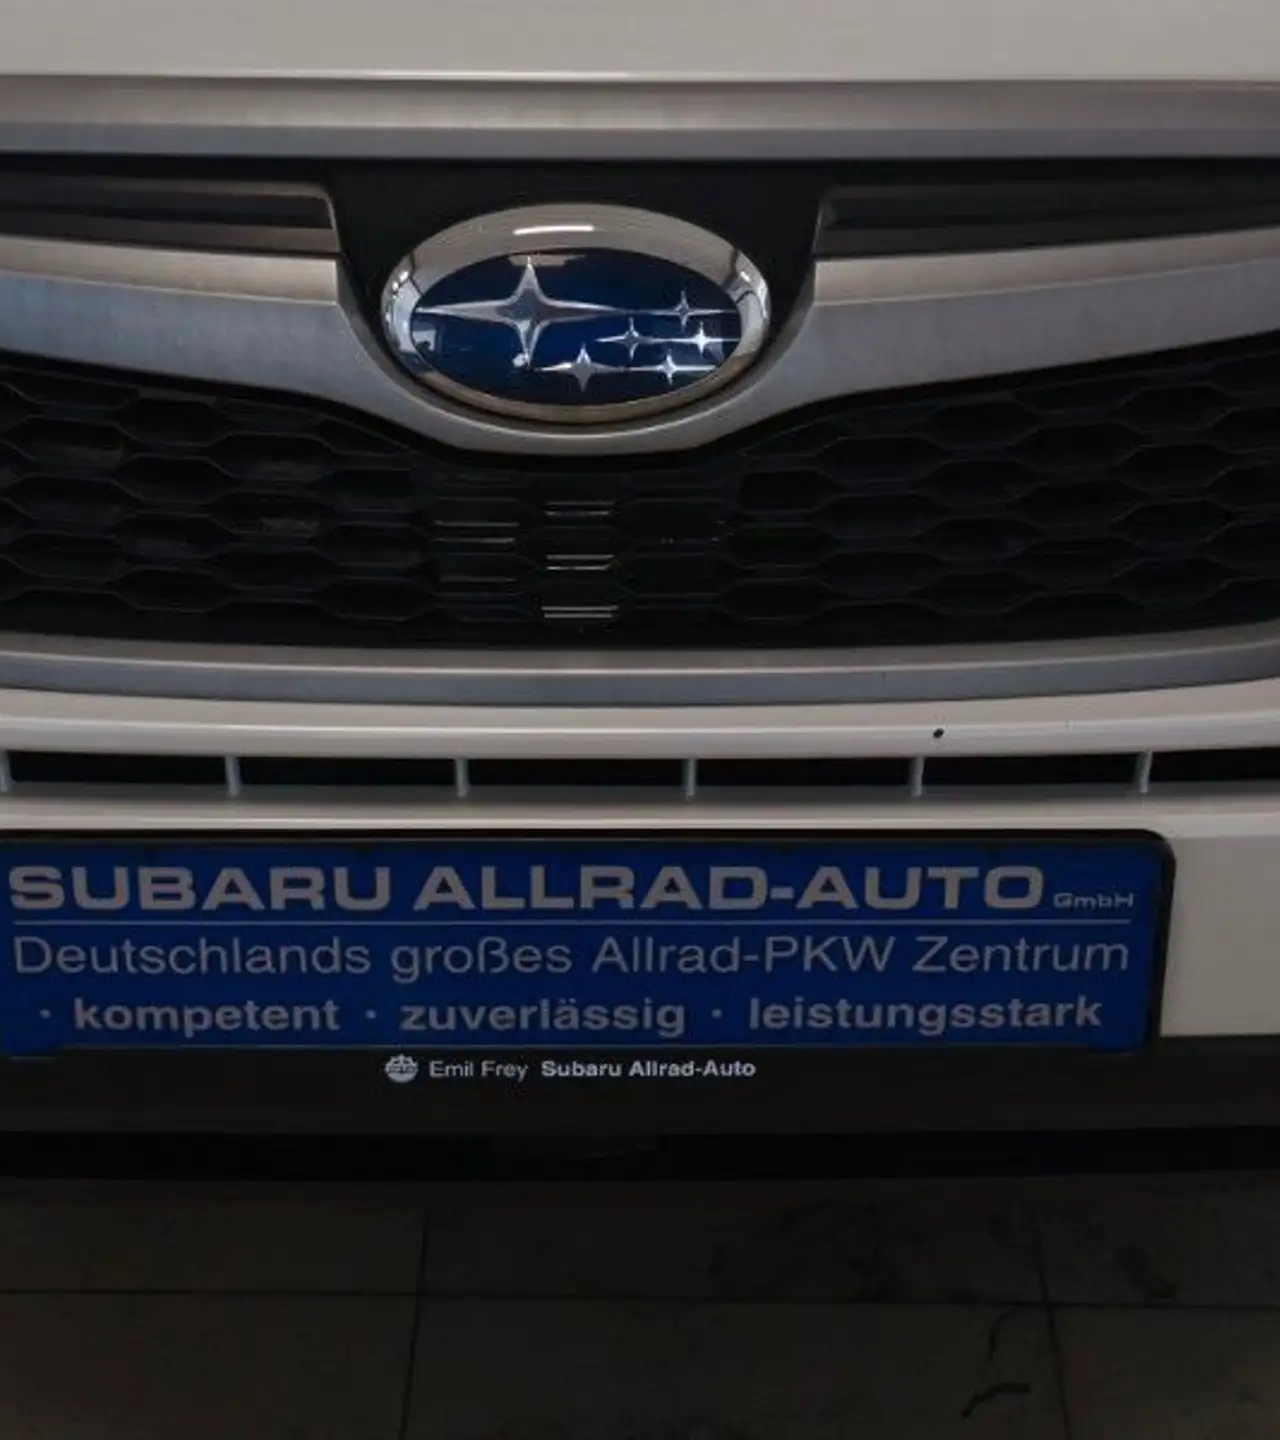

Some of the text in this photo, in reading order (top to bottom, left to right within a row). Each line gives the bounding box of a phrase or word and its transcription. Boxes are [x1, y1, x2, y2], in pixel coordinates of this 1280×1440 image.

[8, 865, 1134, 911] SUBARU ALLRAD-AUTO GmbH
[13, 936, 1128, 983] Deutschlands großes Allrad-PKW Zentrum
[74, 997, 1102, 1037] kompetent zuverlässig leistungsstark
[428, 1059, 757, 1080] Emil Frey Subaru Allrad-Auto
